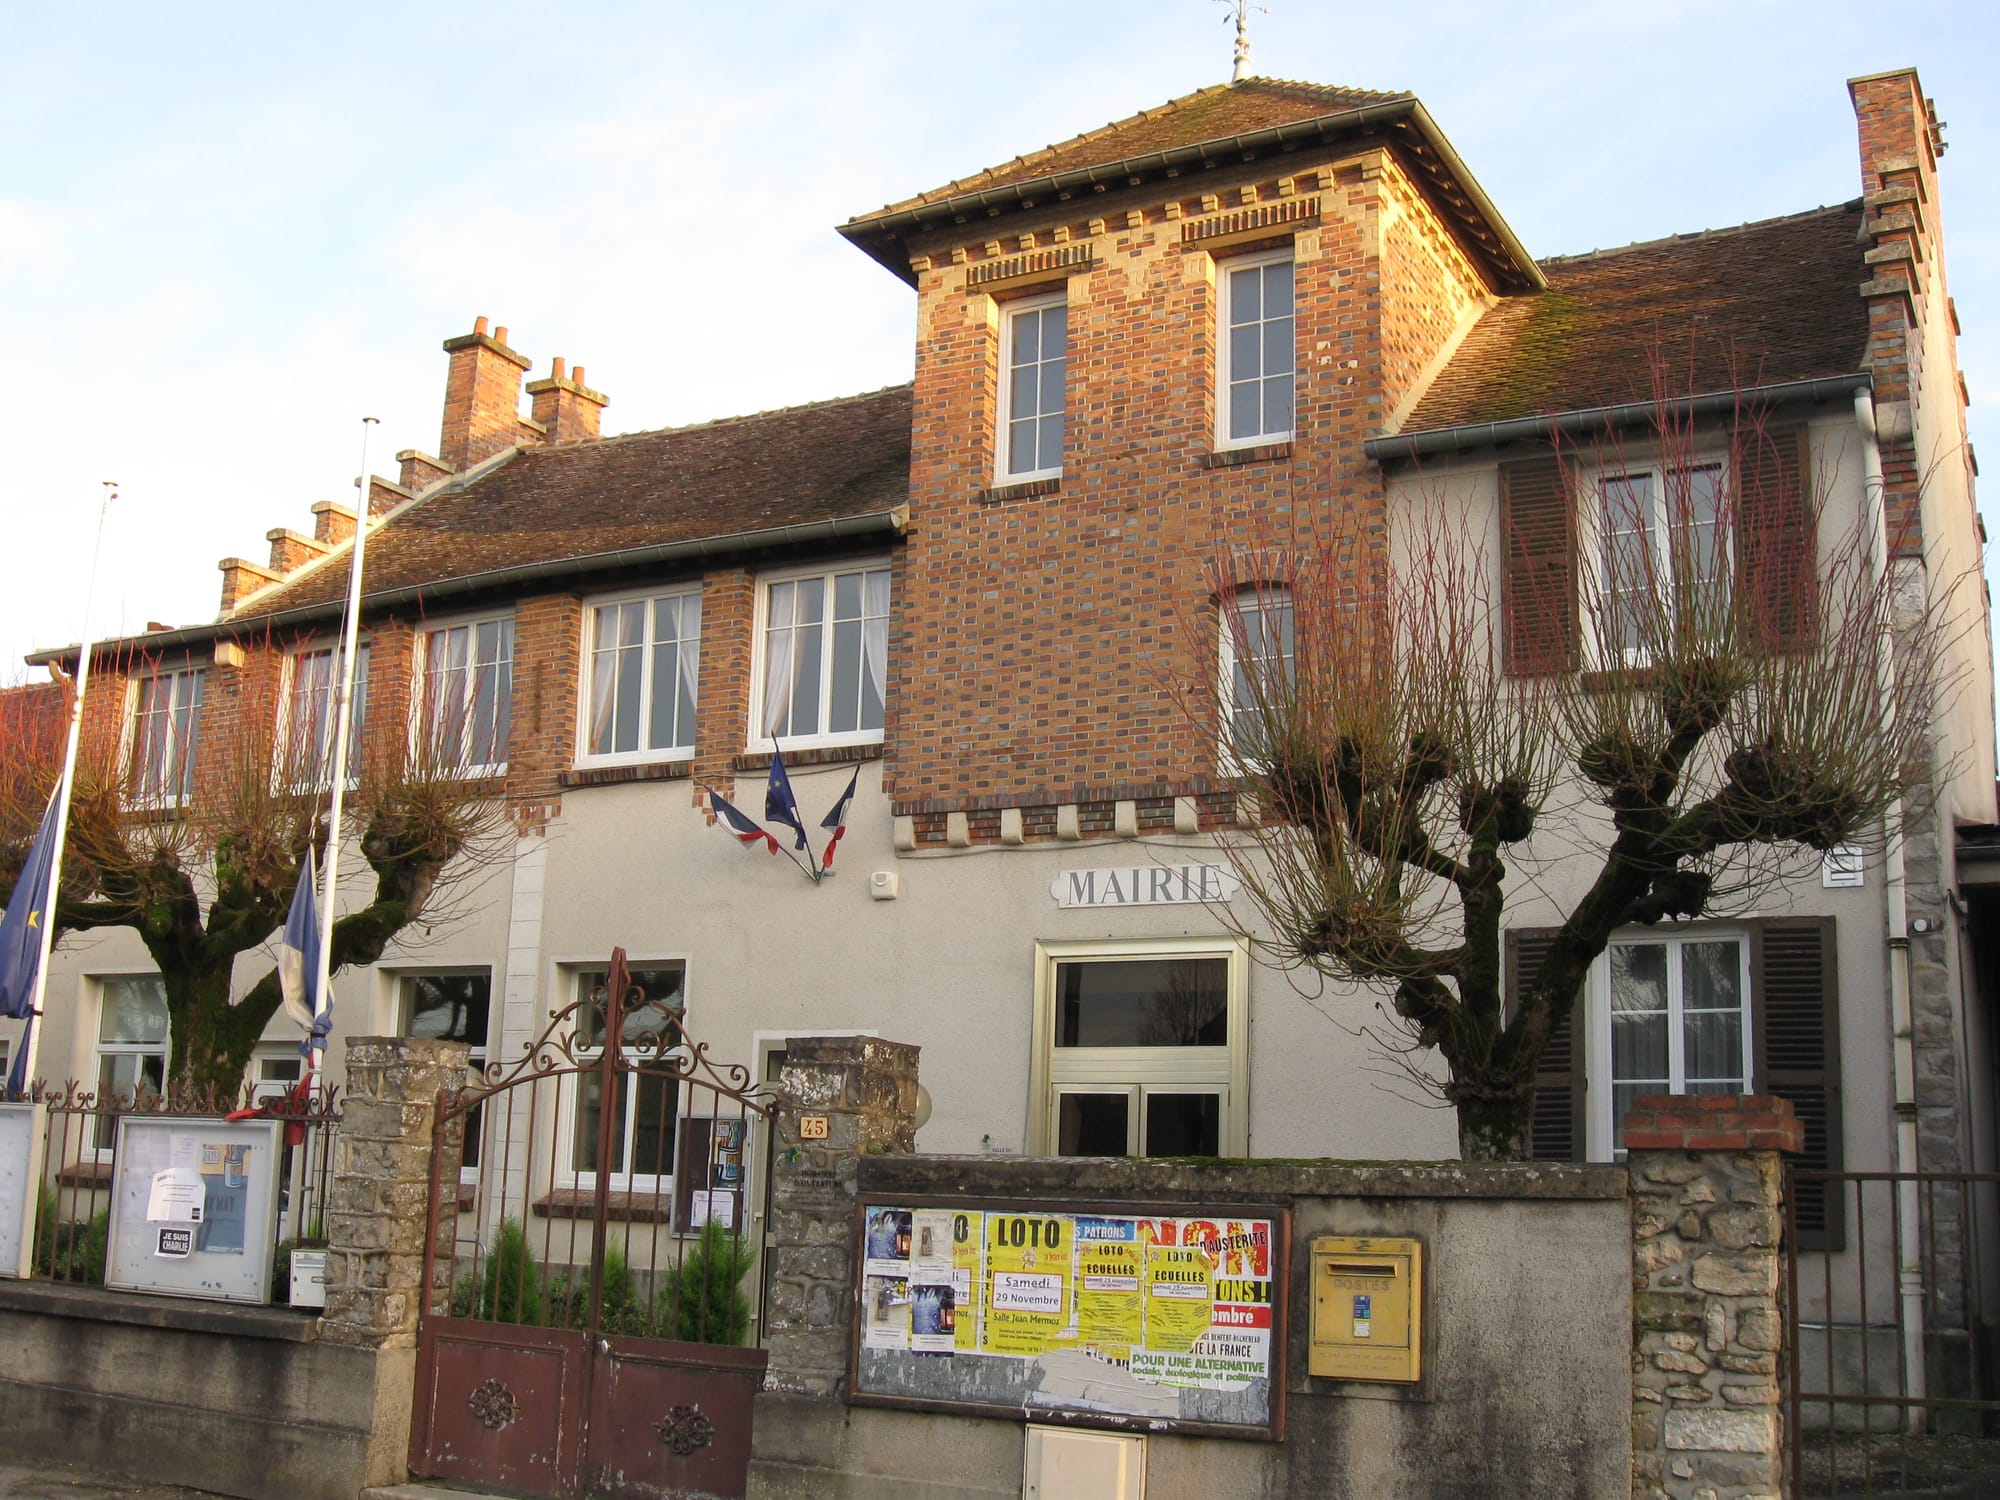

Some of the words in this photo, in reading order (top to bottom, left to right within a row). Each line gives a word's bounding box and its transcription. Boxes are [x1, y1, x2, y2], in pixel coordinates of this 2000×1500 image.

[1066, 865, 1221, 905] MAIRIE
[803, 1120, 824, 1135] 45
[162, 1232, 172, 1240] JE
[173, 1233, 189, 1241] SUIS
[998, 1218, 1060, 1248] LOTO
[1084, 1226, 1126, 1239] PATRONS
[162, 1240, 189, 1251] CHARLIE
[1099, 1245, 1123, 1256] LOTO
[1136, 1220, 1269, 1277] NON
[1167, 1251, 1192, 1262] LOTO
[1087, 1264, 1135, 1275] ECUELLES
[1155, 1270, 1204, 1281] ECUELLES
[1006, 1276, 1050, 1289] Samedi
[1334, 1279, 1391, 1291] POSTES
[996, 1293, 1008, 1301] 29
[1011, 1293, 1059, 1305] Novembre
[993, 1312, 1010, 1322] Salle
[1011, 1313, 1028, 1323] Jean
[1030, 1314, 1059, 1325] Mermoz
[1207, 1343, 1216, 1356] LA
[1220, 1344, 1252, 1358] FRANCE
[1132, 1354, 1164, 1366] POUR
[1168, 1356, 1191, 1368] UNE
[1195, 1358, 1265, 1373] ALTERNATIVE
[1165, 1367, 1211, 1380] écologique
[1214, 1372, 1224, 1380] et
